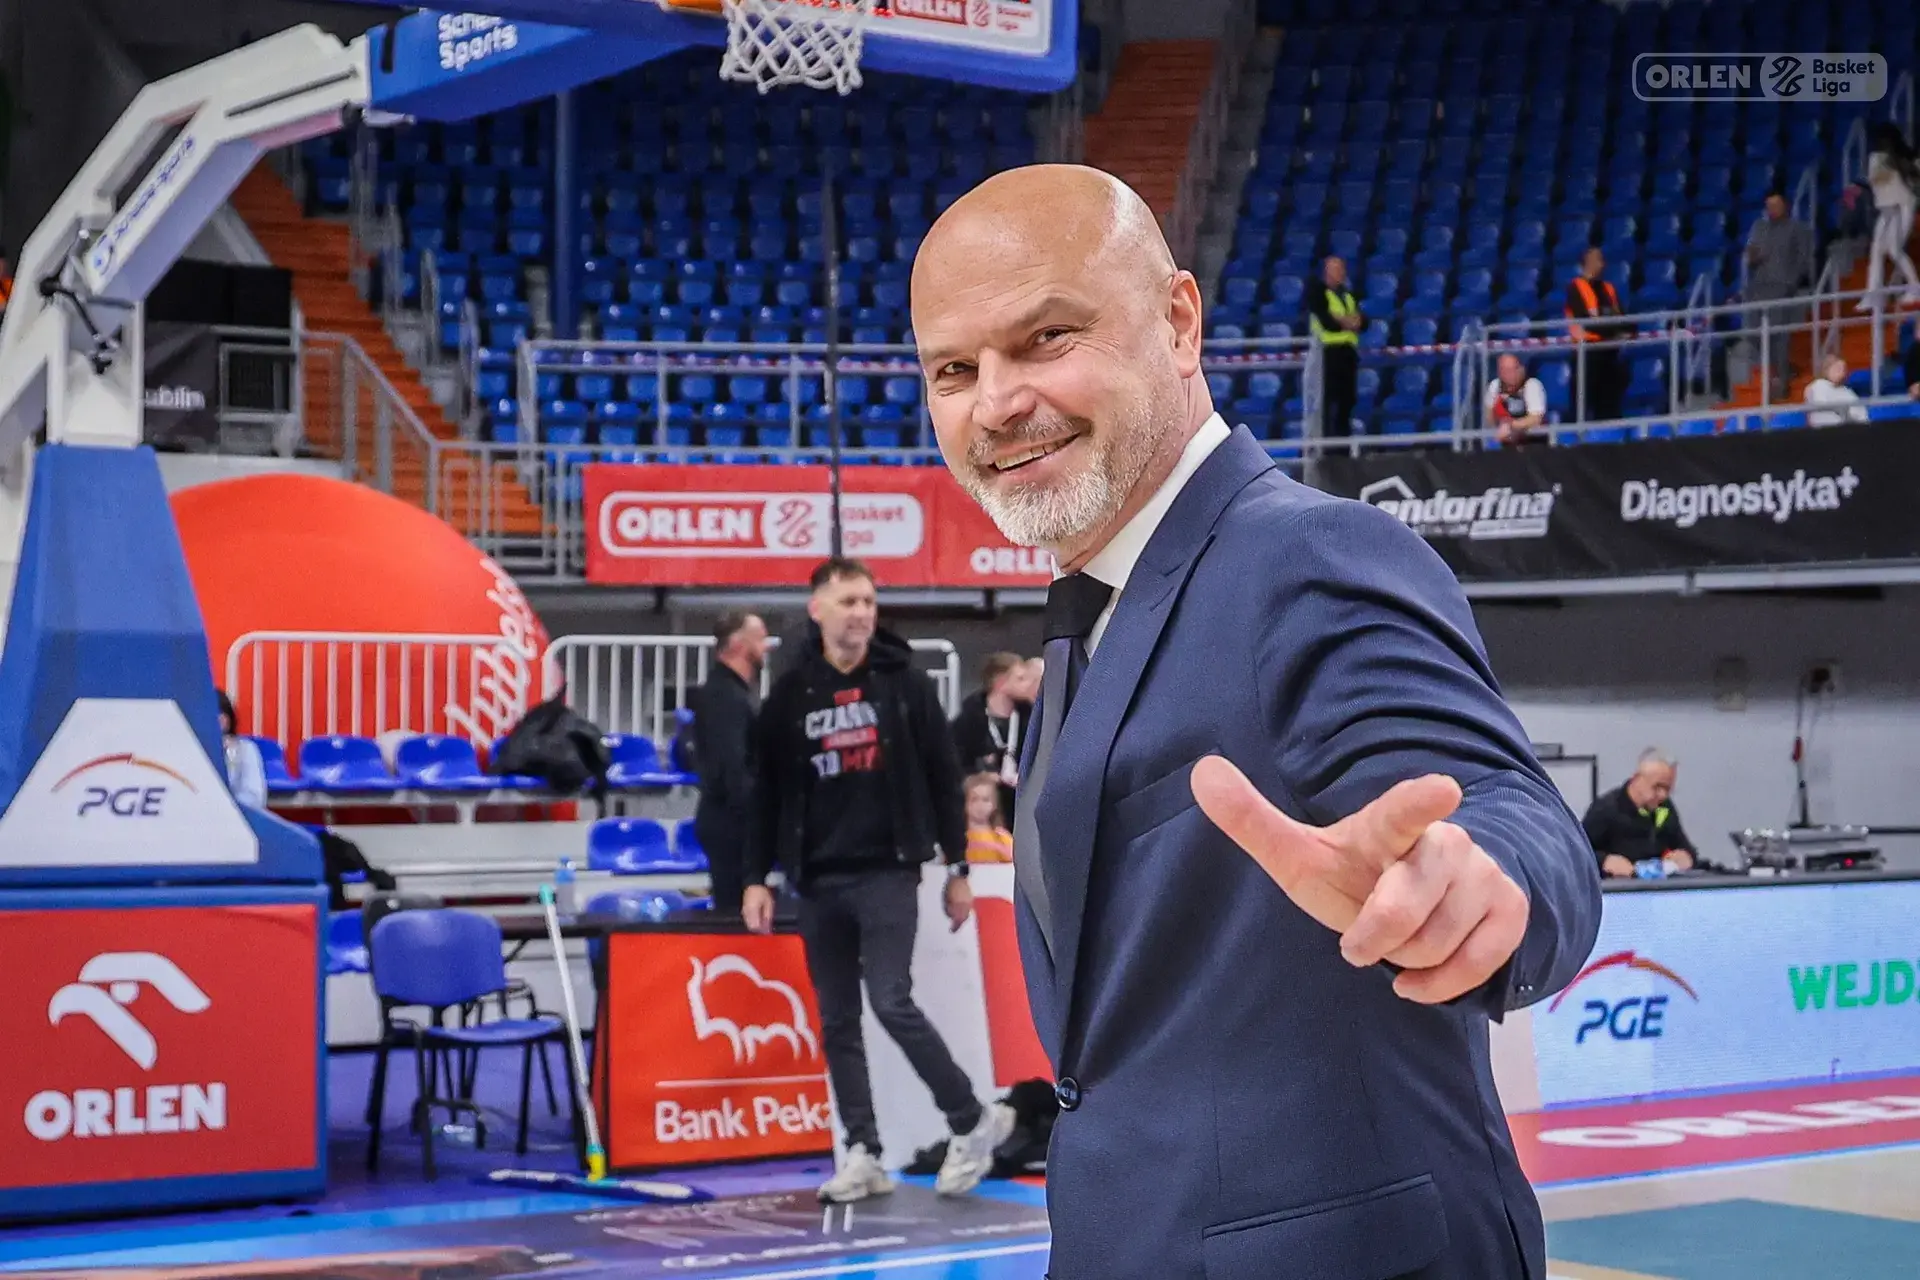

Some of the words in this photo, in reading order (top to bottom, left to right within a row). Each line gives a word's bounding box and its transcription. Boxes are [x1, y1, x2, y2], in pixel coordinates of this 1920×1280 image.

[439, 24, 519, 73] Sports
[616, 506, 755, 542] ORLEN
[970, 546, 1052, 576] ORLE
[77, 786, 167, 817] PGE
[1787, 957, 1920, 1012] WEJD
[1575, 994, 1670, 1044] PGE
[23, 1081, 228, 1142] ORLEN
[655, 1098, 750, 1144] Bank
